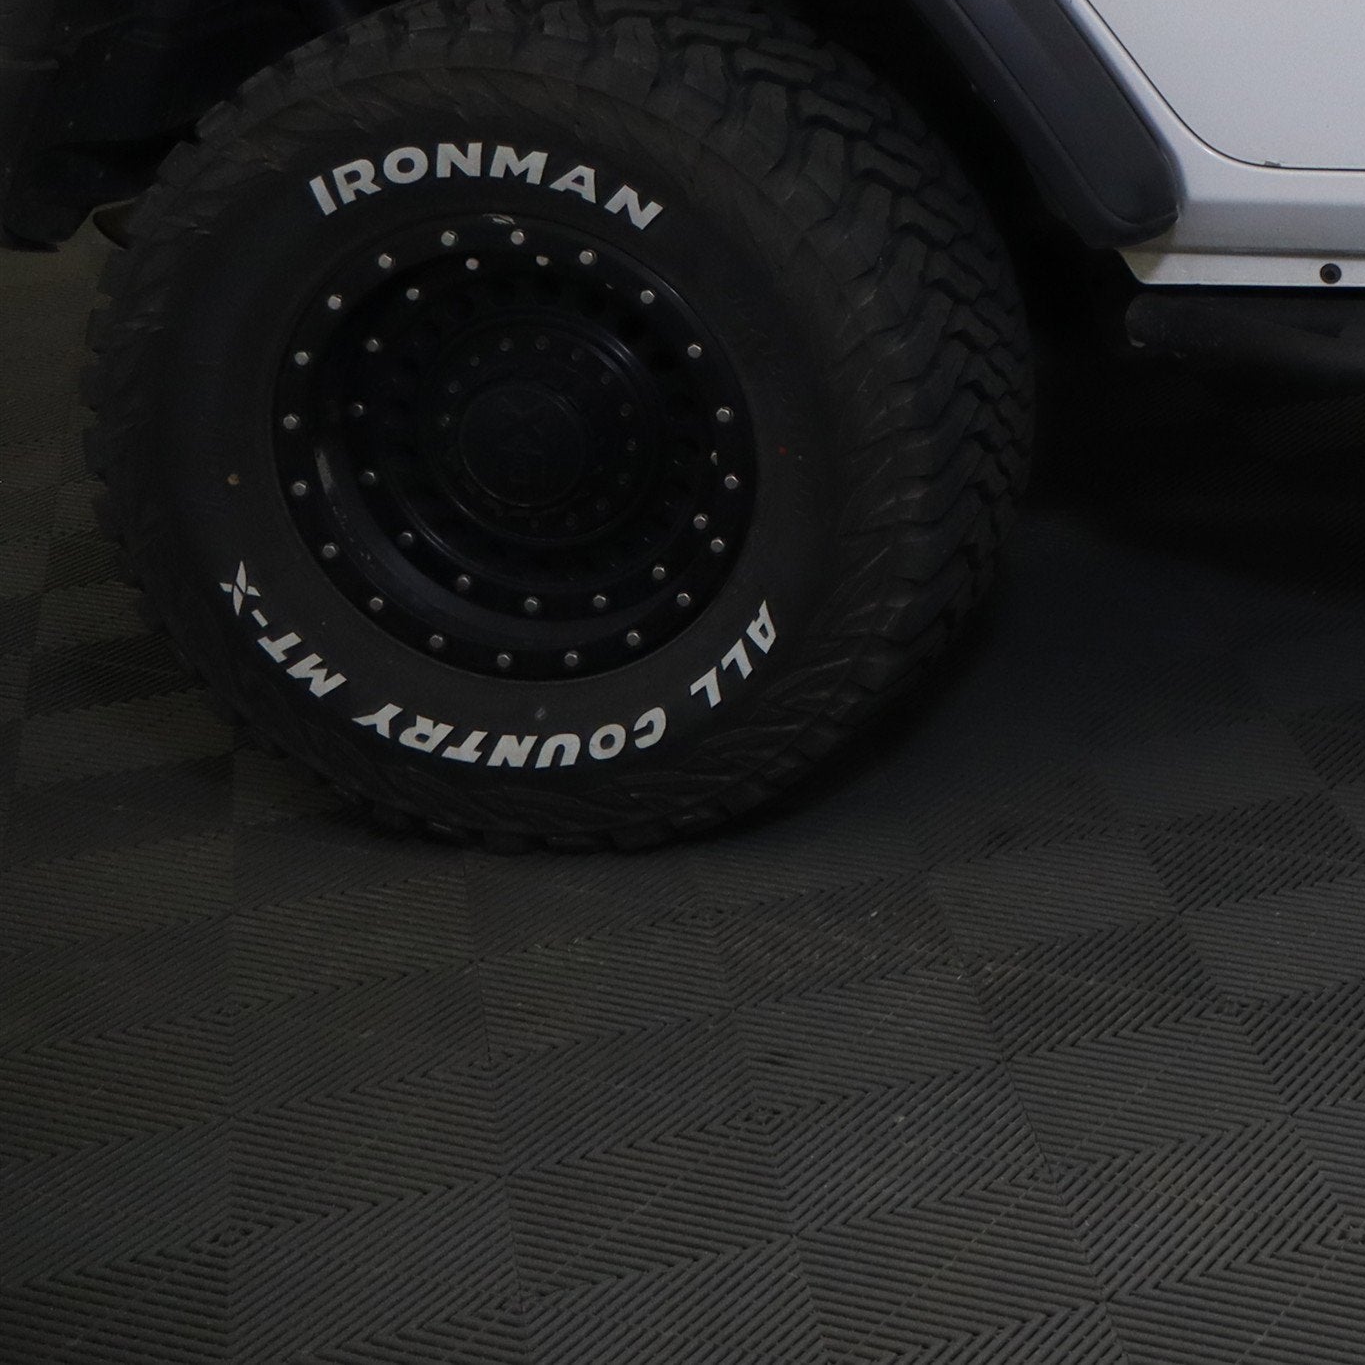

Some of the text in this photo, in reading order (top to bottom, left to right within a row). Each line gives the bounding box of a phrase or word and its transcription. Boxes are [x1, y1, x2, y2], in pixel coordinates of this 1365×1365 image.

[308, 142, 664, 230] IRONMAN
[219, 560, 777, 769] ALL COUNTRY MT-X
